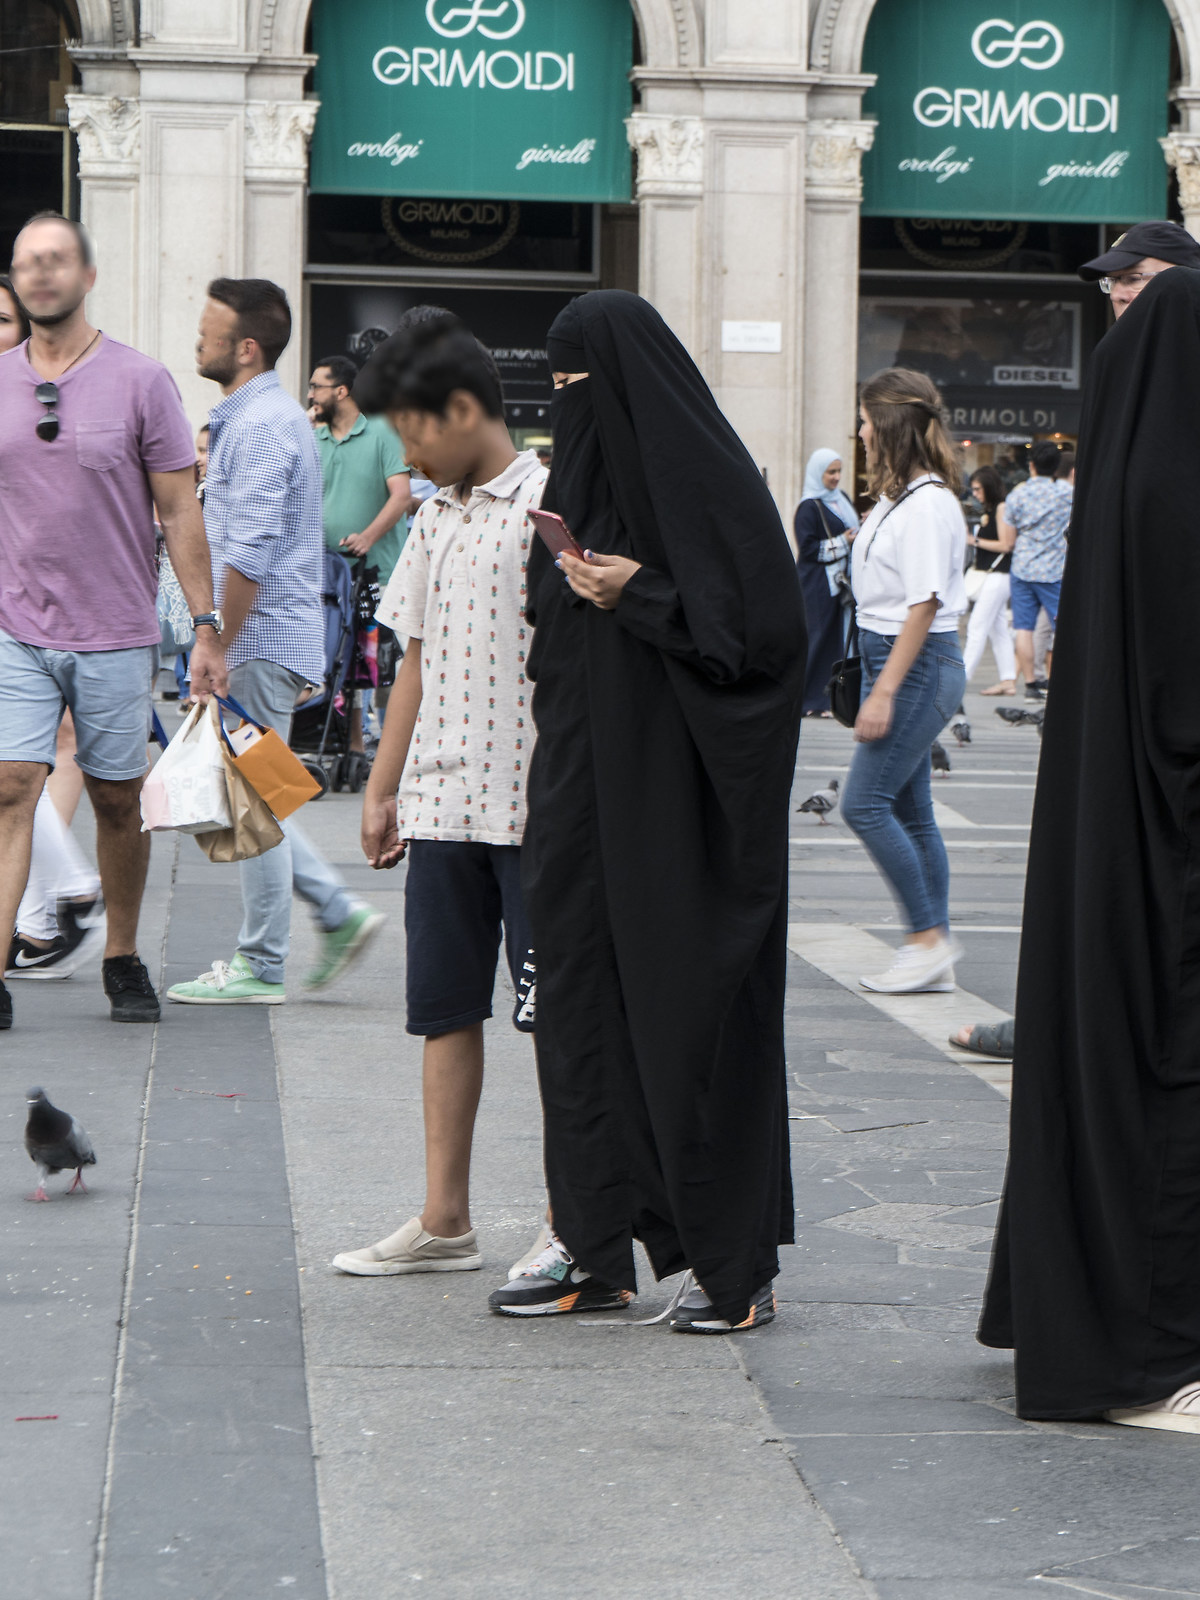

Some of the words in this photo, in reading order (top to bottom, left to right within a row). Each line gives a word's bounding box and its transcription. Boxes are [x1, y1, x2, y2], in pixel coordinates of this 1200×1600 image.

[372, 45, 575, 91] GRIMOLDI
[912, 86, 1119, 133] GRIMOLDI
[347, 131, 424, 167] orologi
[515, 138, 597, 171] gioielli
[898, 145, 975, 183] orologi
[1038, 150, 1130, 186] gioielli
[399, 201, 503, 225] GRIMOLDI
[430, 228, 470, 240] MILANO
[999, 370, 1072, 382] DIESEL
